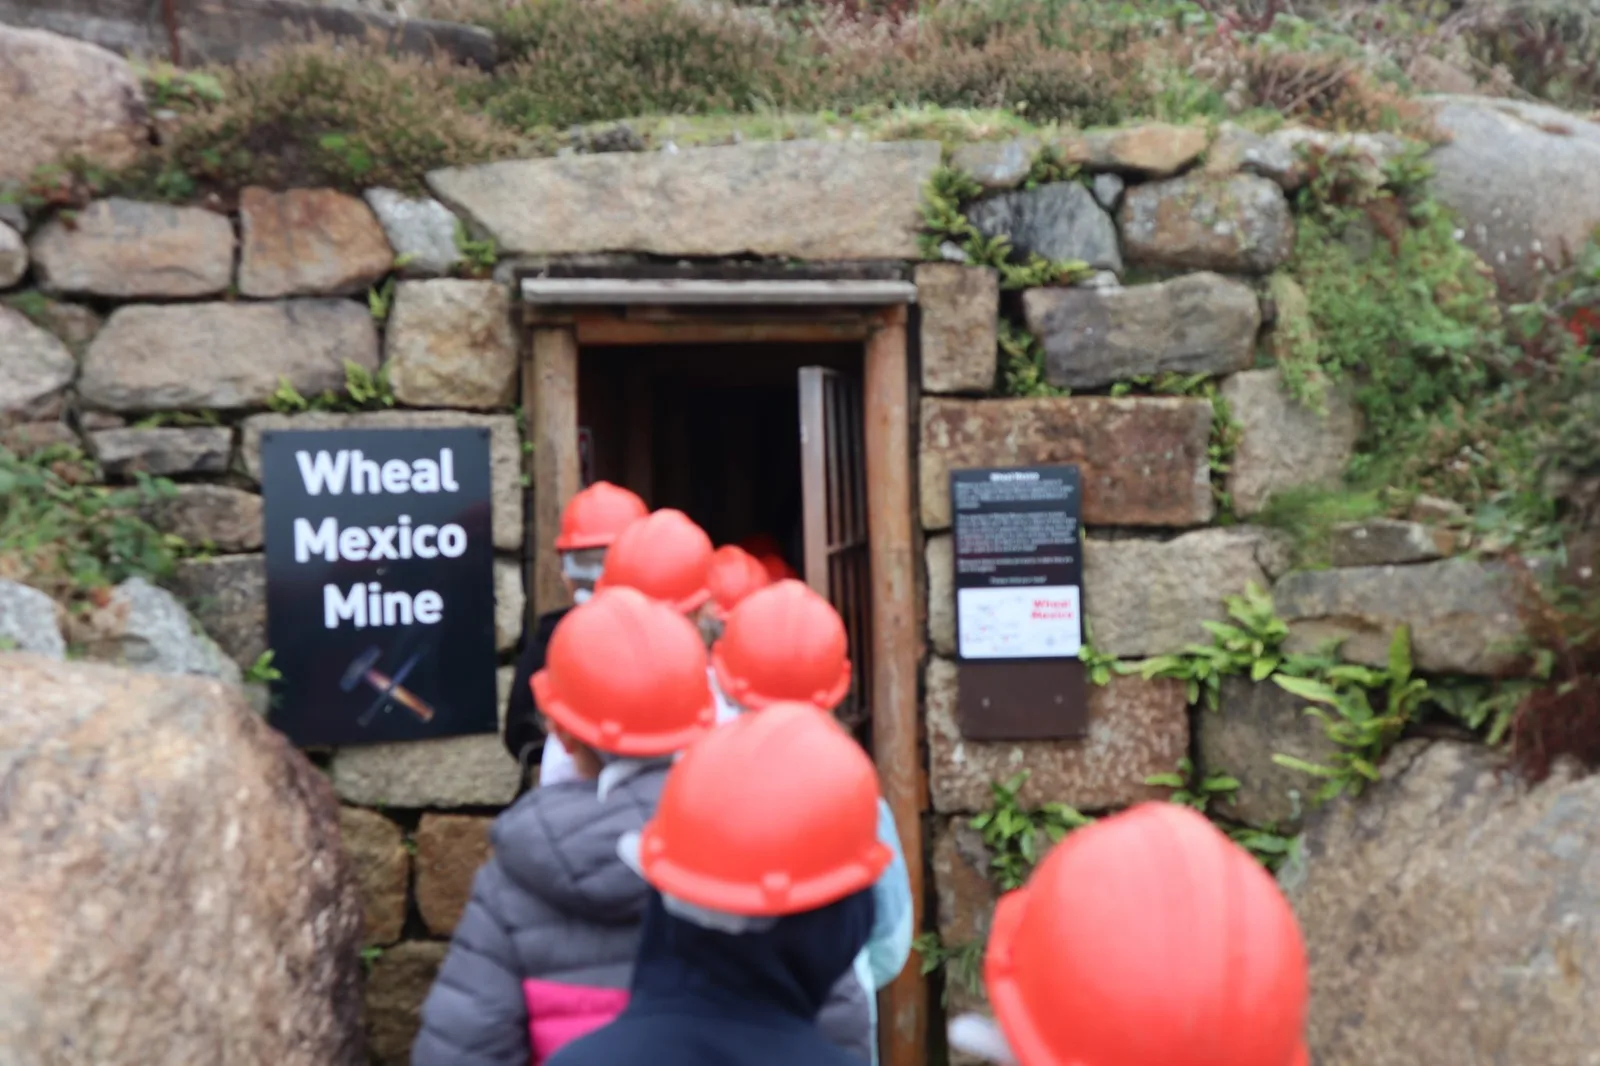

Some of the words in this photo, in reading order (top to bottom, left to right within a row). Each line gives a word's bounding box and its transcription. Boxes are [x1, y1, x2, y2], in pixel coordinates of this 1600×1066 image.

[295, 447, 460, 496] Wheal
[293, 514, 468, 563] Mexico
[323, 582, 444, 629] Mine
